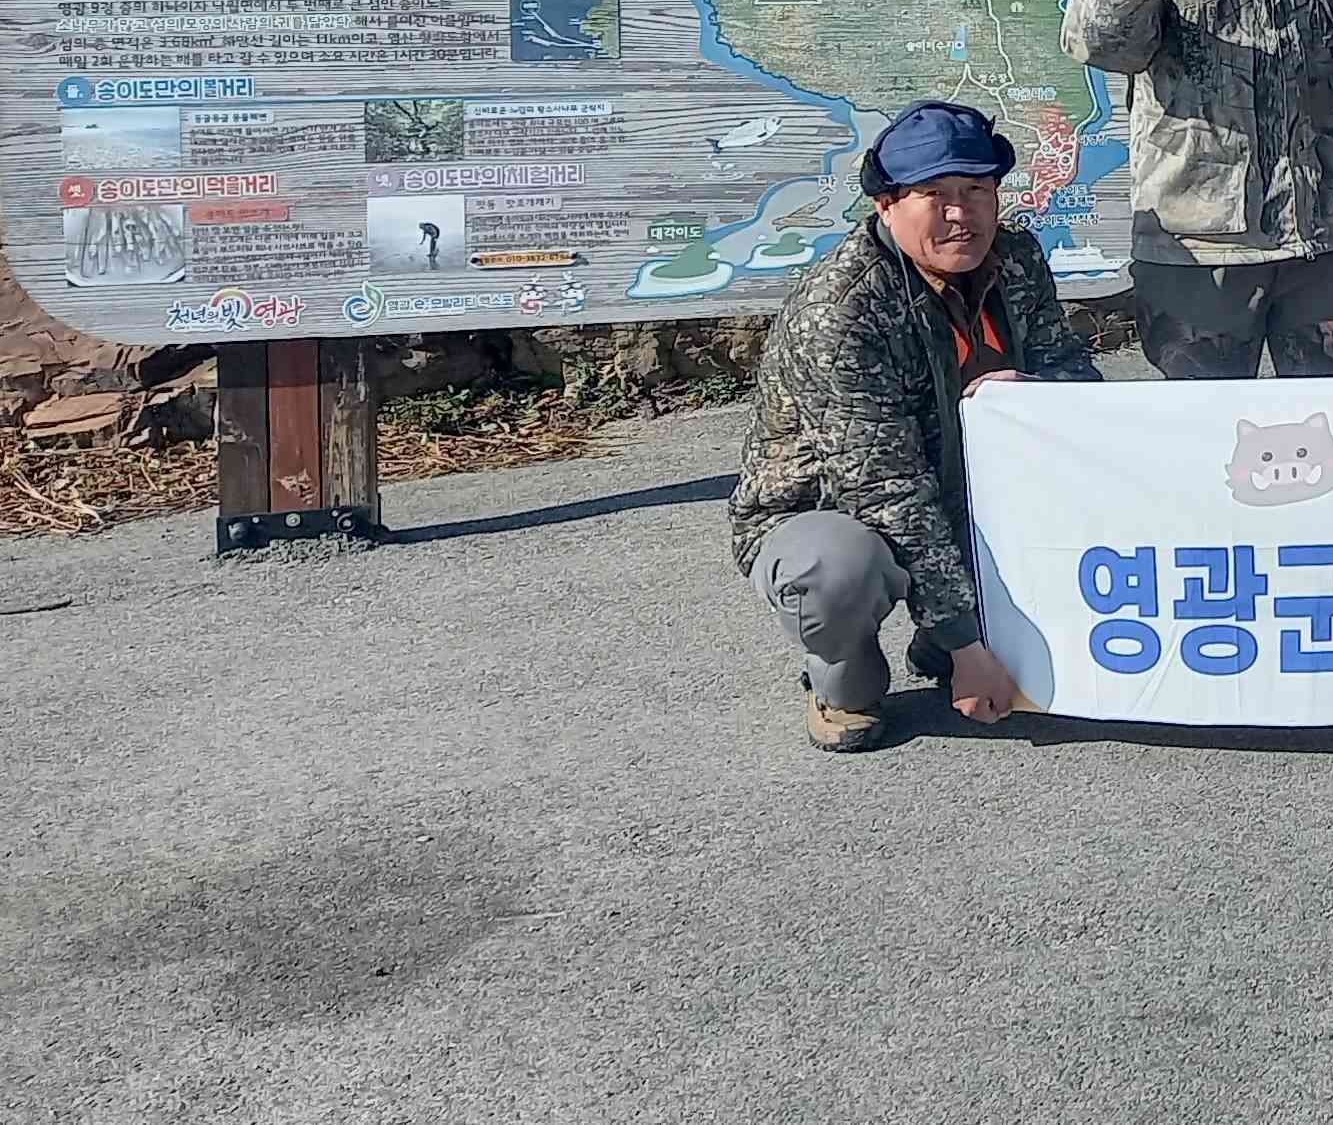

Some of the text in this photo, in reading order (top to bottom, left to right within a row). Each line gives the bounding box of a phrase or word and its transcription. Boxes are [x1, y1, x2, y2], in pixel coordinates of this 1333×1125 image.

[96, 78, 198, 101] 송이도만의
[406, 168, 501, 189] 송이도만의
[504, 164, 585, 187] 체험거리
[650, 227, 704, 241] 대각이도
[254, 295, 305, 326] 영광
